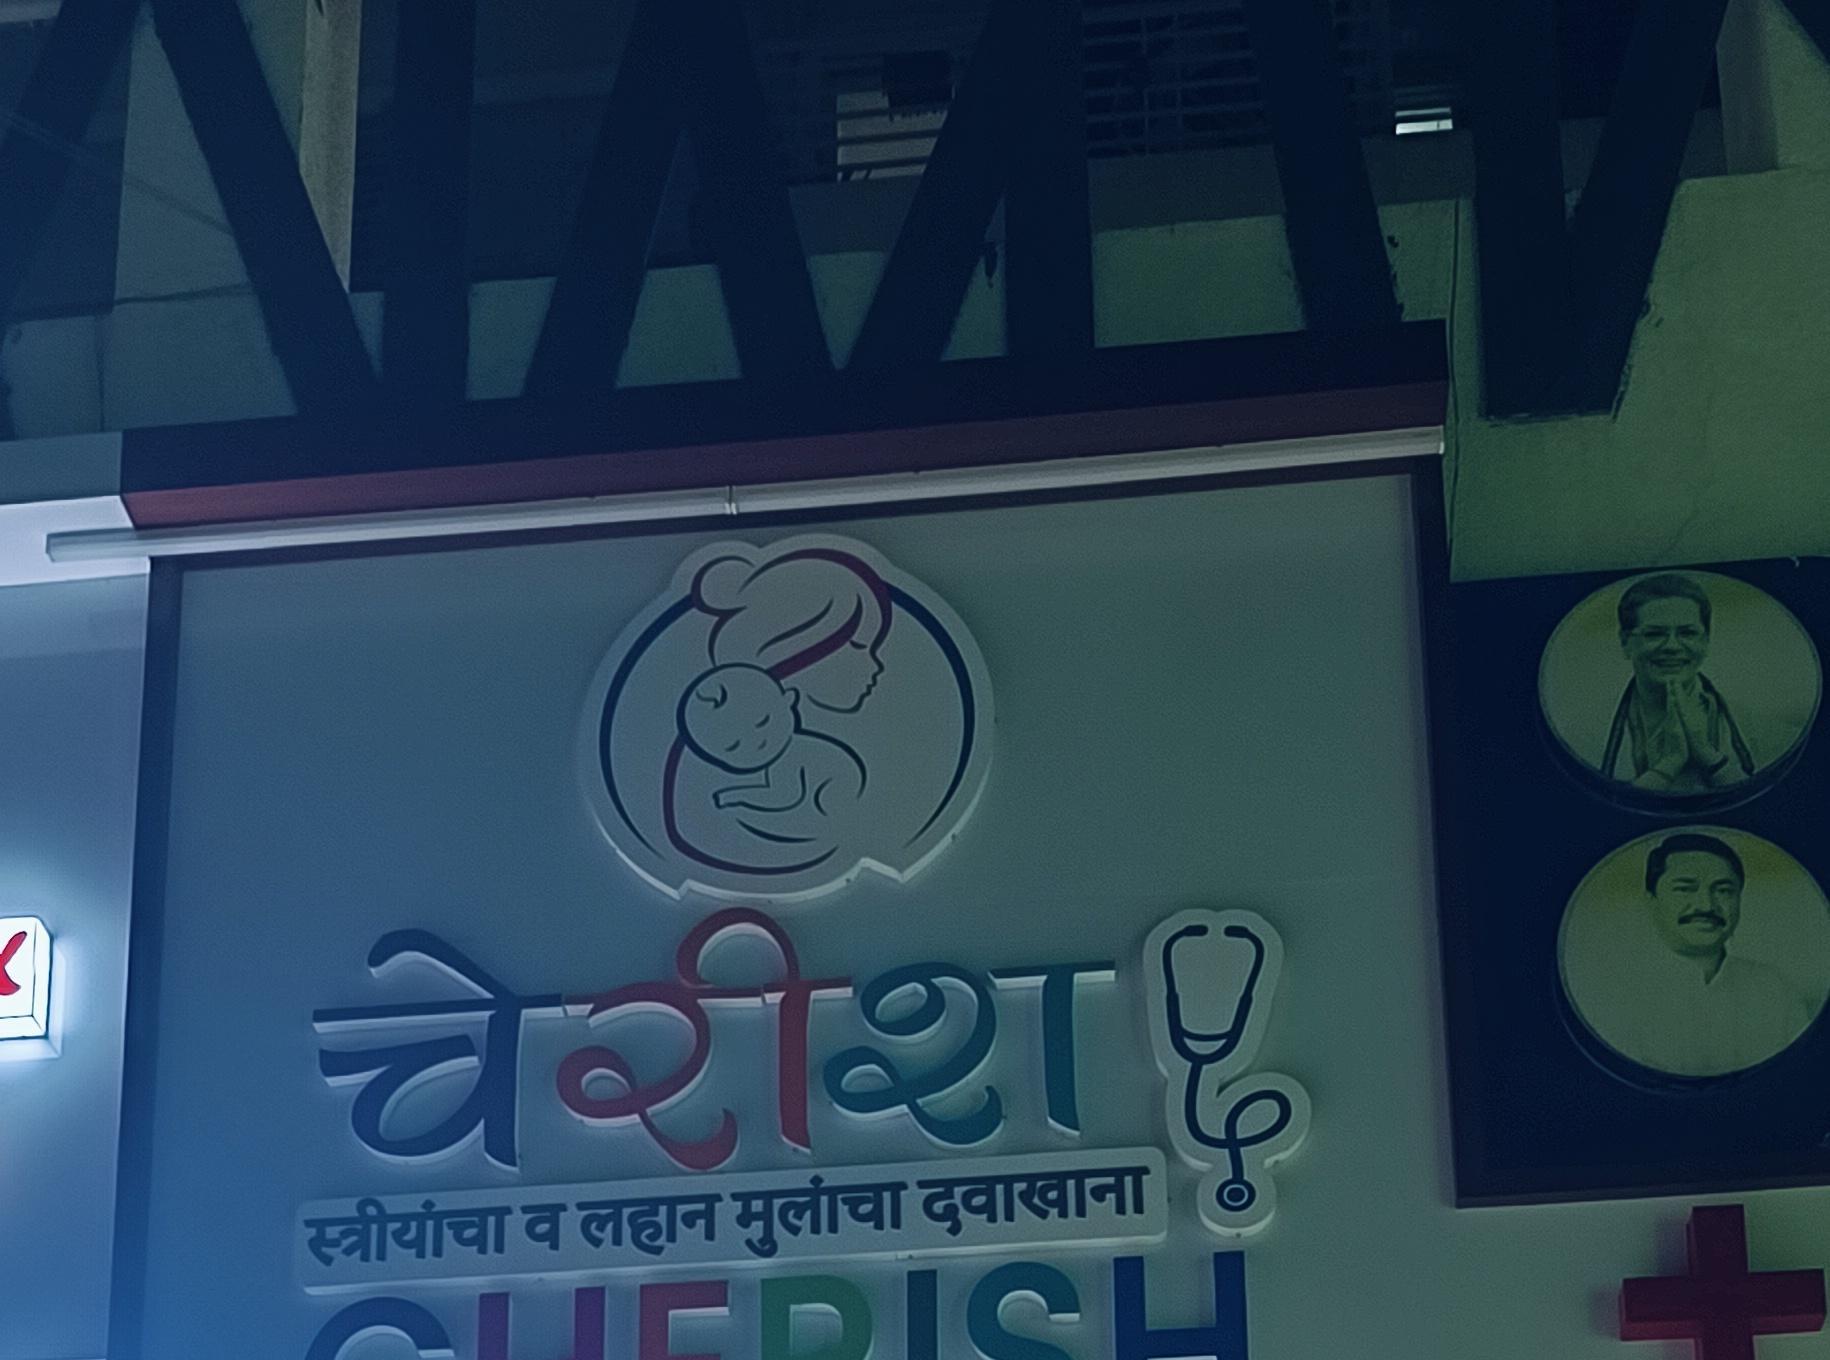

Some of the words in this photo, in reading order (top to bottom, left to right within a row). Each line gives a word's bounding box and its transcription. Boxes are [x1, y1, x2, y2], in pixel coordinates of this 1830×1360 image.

[303, 1198, 512, 1267] स्त्रीयांचा
[521, 1203, 568, 1252] व
[574, 1193, 723, 1256] लहान
[730, 1174, 908, 1258] मुलांचा
[916, 1165, 1151, 1236] दवाखाना
